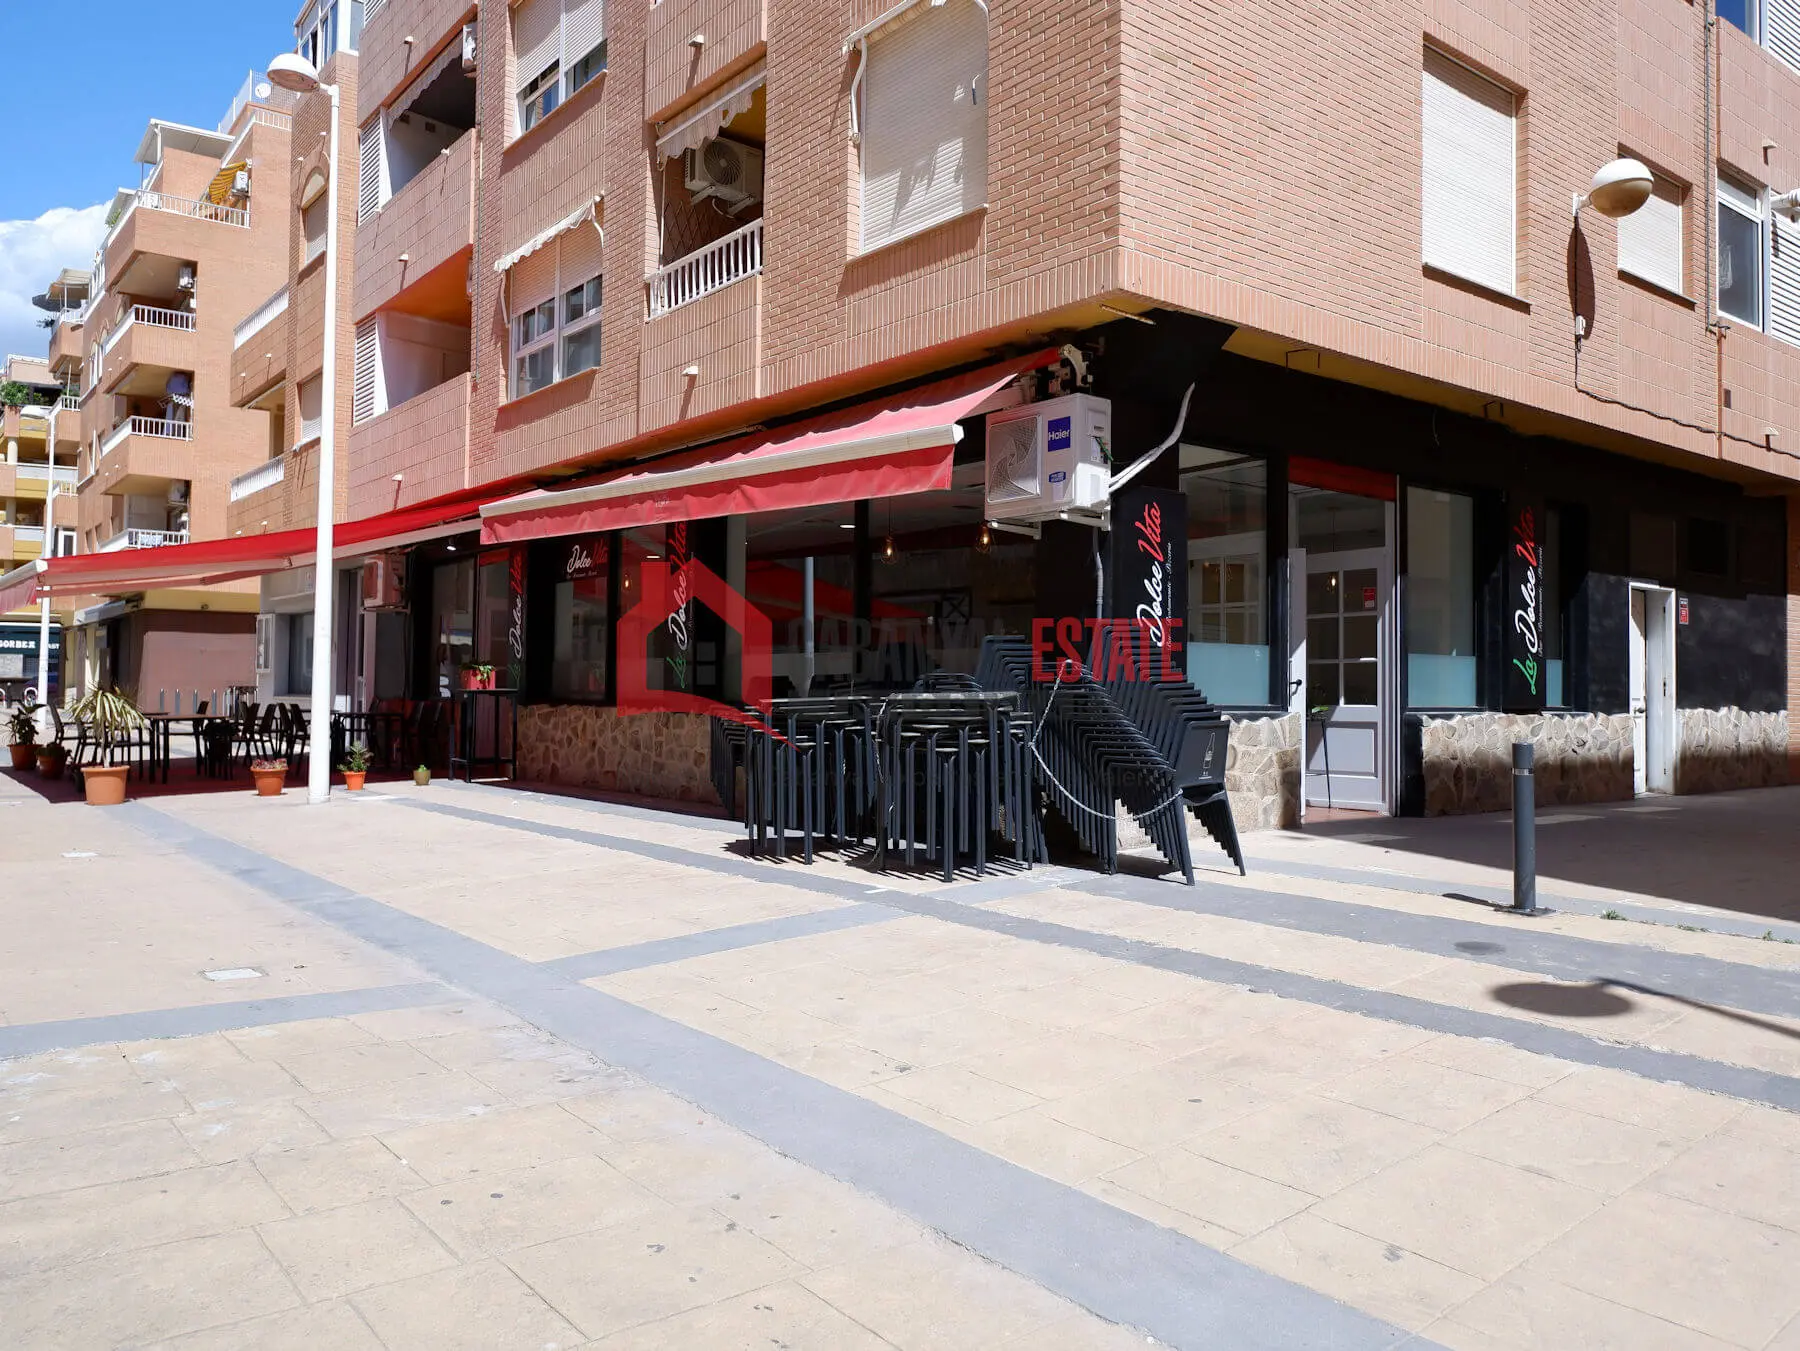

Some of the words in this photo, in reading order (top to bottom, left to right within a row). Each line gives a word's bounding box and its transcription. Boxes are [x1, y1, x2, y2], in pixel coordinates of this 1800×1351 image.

[1048, 429, 1070, 441] Haier
[566, 544, 592, 573] Dolce
[1135, 502, 1164, 562] Vita
[1513, 506, 1538, 567] Vita
[509, 594, 522, 659] Dolce
[668, 571, 688, 651] Dolce
[1137, 560, 1166, 648] Dolce
[1514, 566, 1537, 653] Dolce
[666, 651, 687, 689] La
[1513, 654, 1537, 695] La
